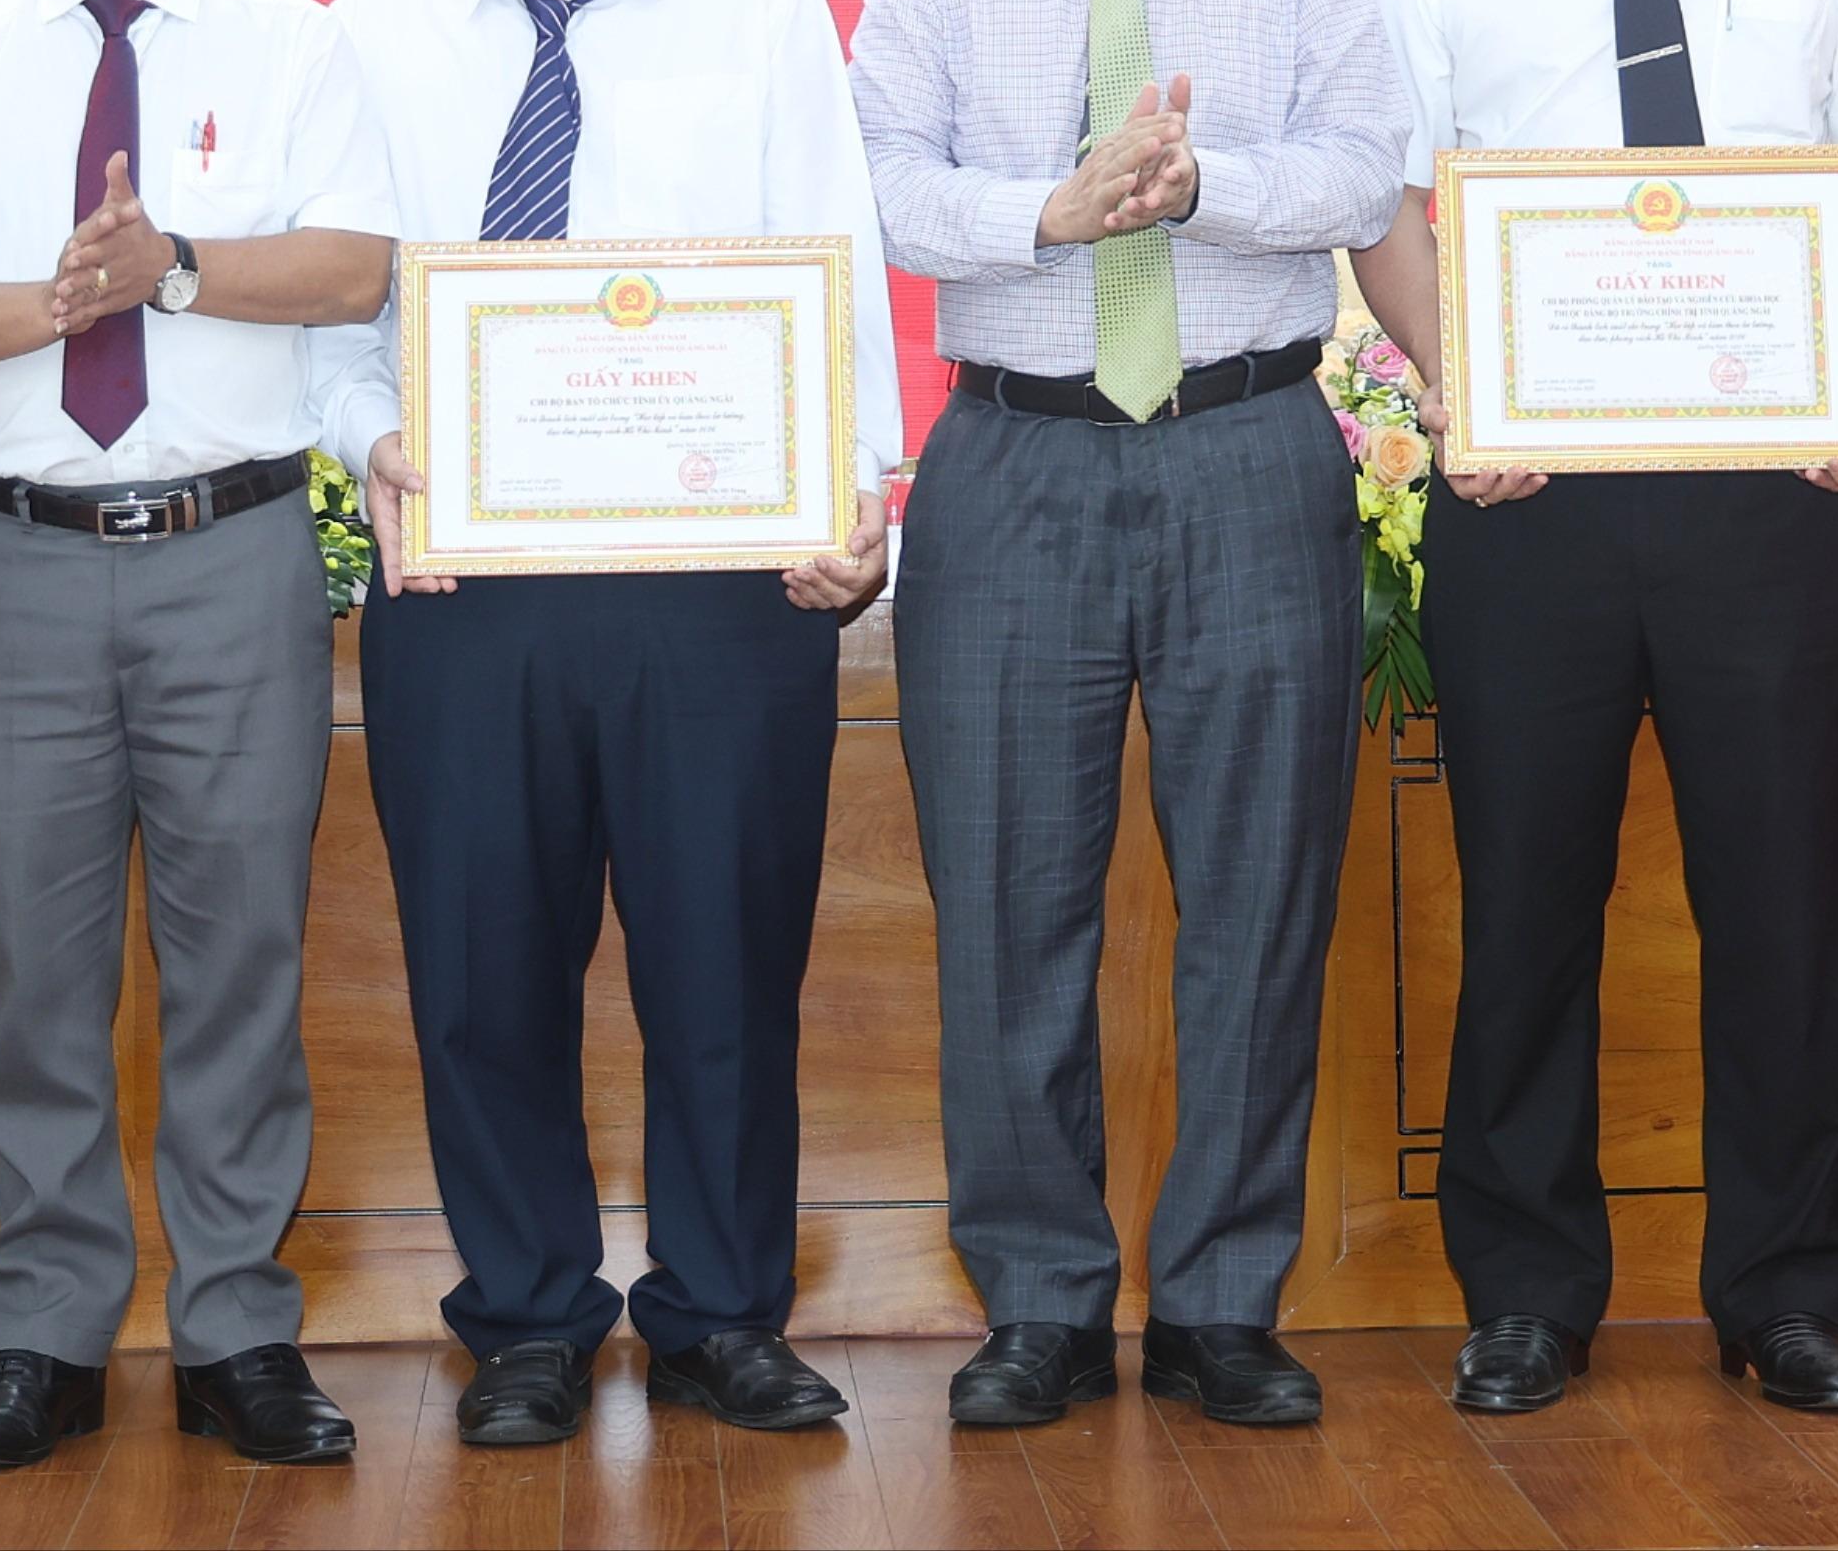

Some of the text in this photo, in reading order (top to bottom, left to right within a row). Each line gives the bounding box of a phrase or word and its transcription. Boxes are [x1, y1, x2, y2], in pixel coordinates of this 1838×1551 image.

[1595, 269, 1726, 291] GIẤY KHEN
[566, 365, 698, 388] GIẤY KHEN
